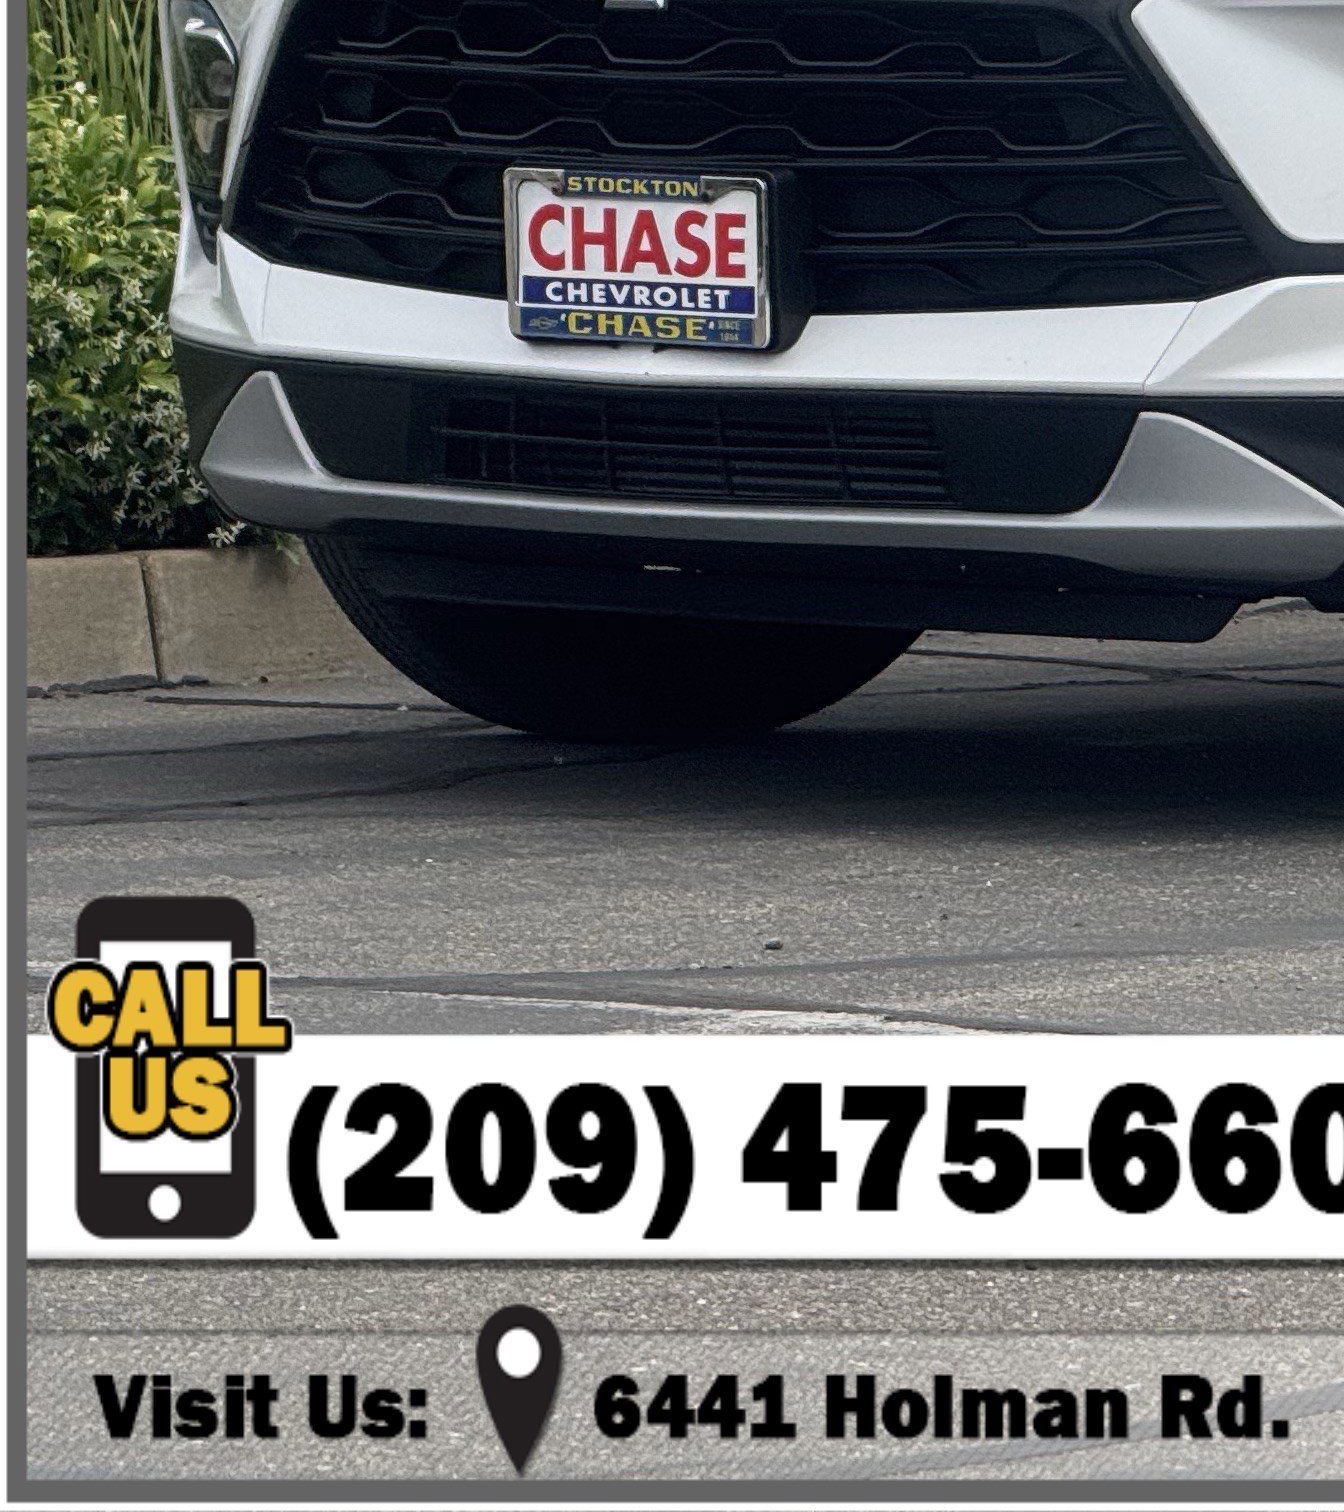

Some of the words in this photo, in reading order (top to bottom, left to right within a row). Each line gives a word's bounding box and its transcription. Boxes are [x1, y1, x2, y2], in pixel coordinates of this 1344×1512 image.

[567, 176, 698, 197] STOCKTON
[528, 203, 746, 279] CHASE
[545, 281, 730, 310] CHEVROLET
